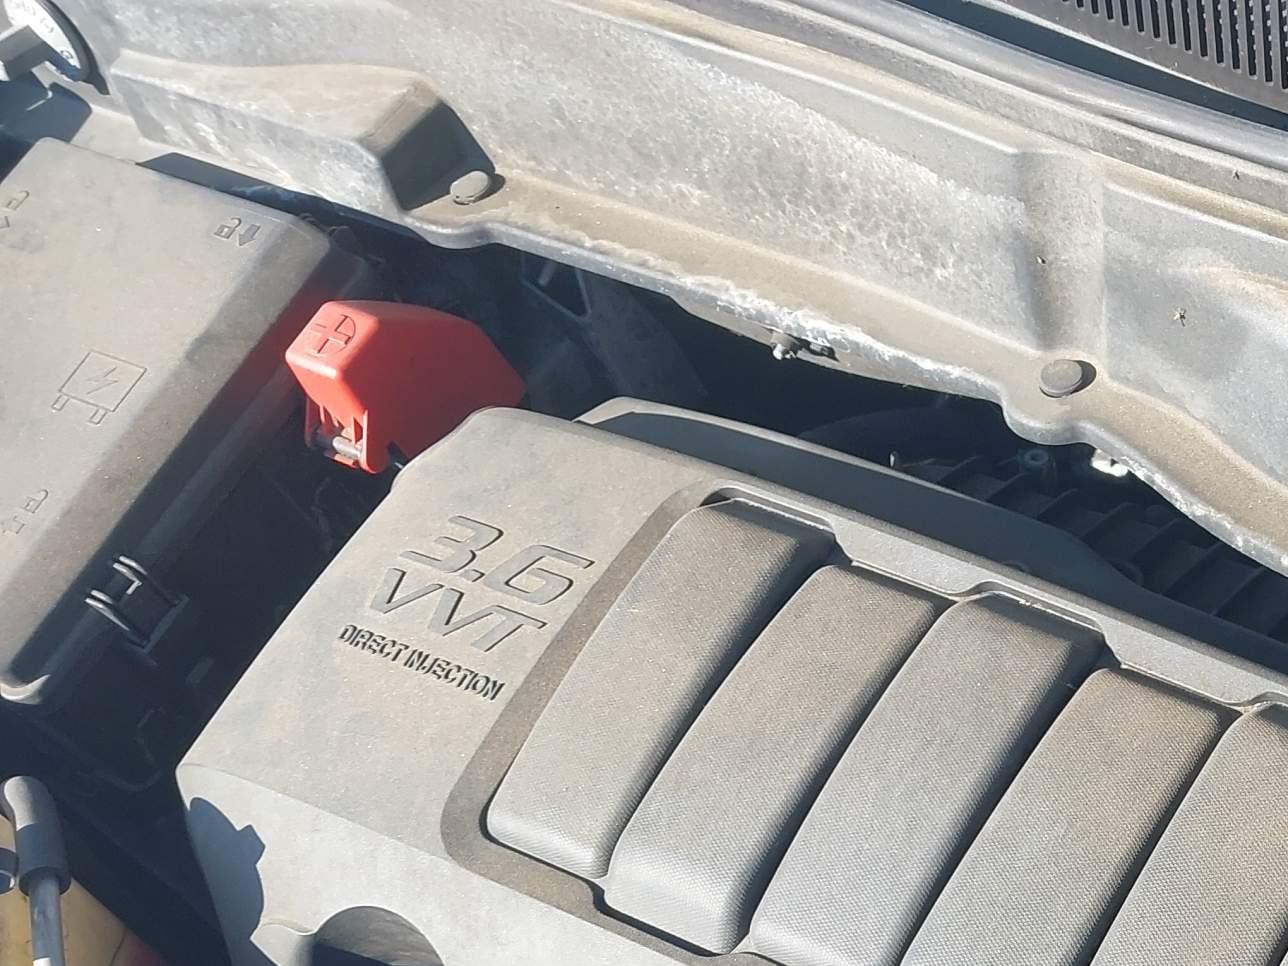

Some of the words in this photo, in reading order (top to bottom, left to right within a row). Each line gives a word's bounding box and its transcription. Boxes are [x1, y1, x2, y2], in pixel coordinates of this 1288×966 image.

[400, 515, 596, 606] 3.6
[369, 567, 548, 653] VVT
[337, 623, 410, 663] DIRECT
[404, 648, 506, 701] INJECTION
